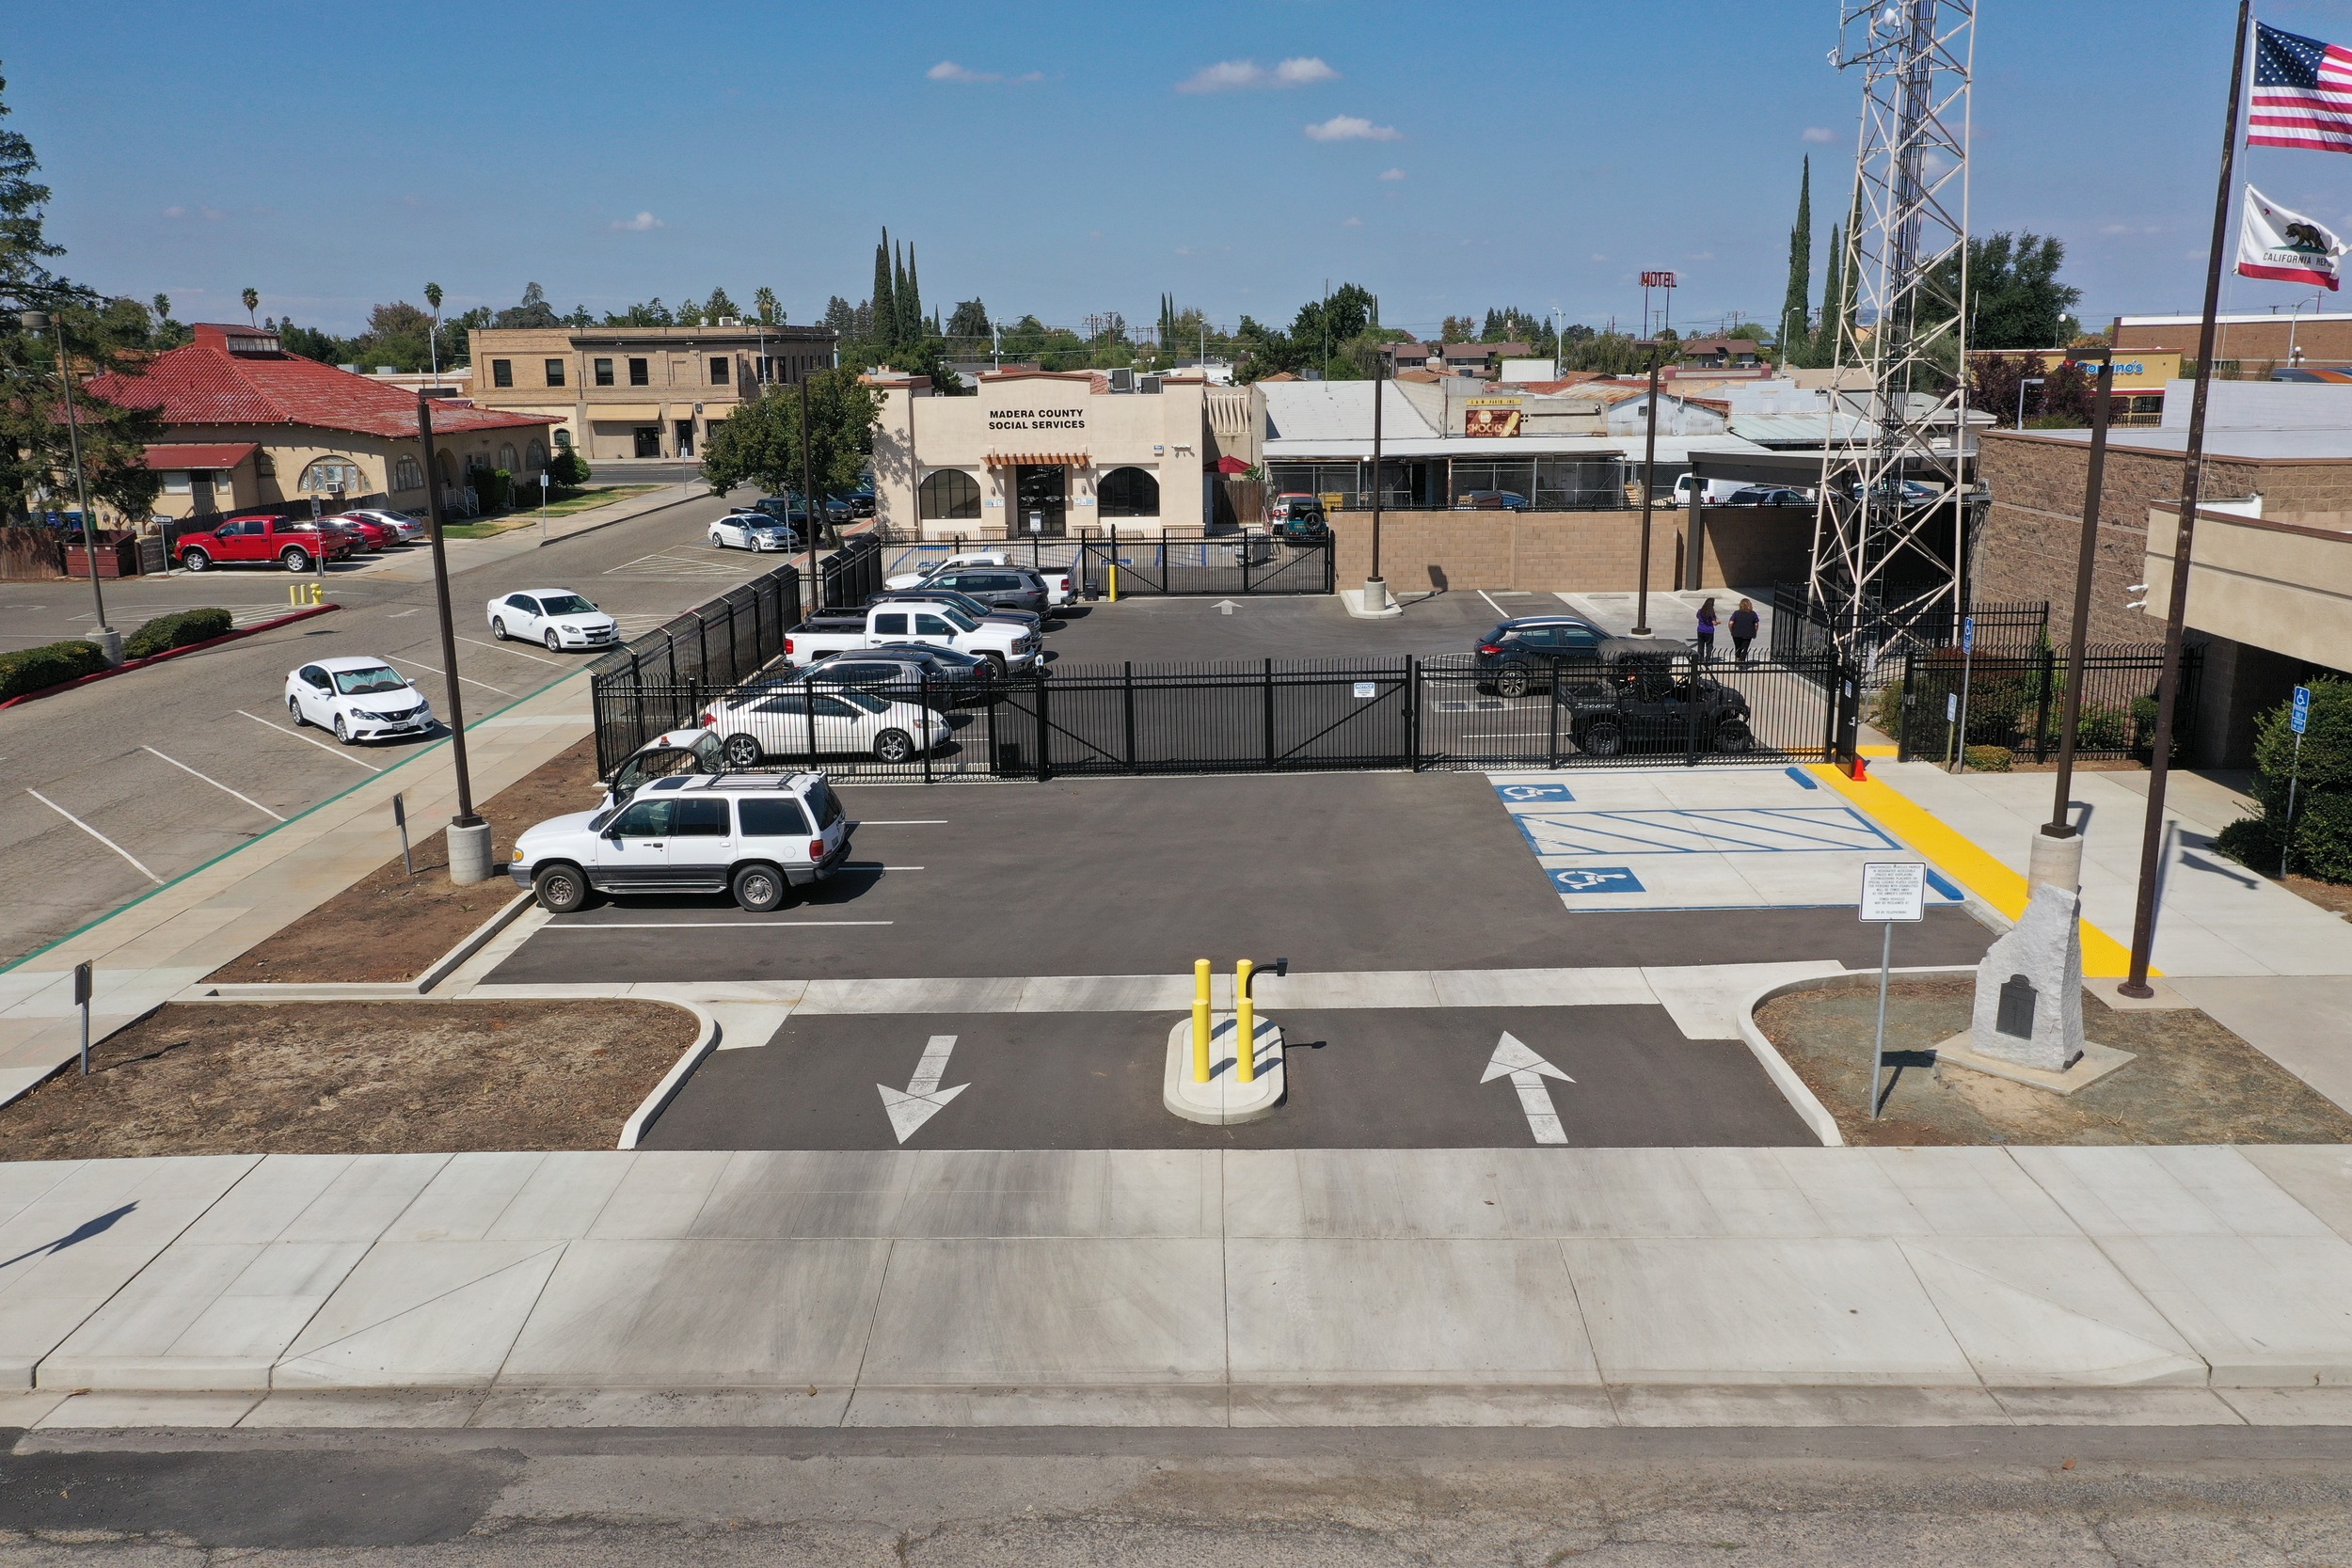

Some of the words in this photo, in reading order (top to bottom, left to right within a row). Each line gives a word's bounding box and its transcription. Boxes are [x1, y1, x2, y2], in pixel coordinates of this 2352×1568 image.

[2263, 252, 2312, 264] CALIFORNIA
[1641, 271, 1677, 287] MOTEL
[2075, 361, 2143, 373] ono's
[990, 410, 1035, 419] MADERA
[1039, 409, 1084, 418] COUNTY
[989, 421, 1028, 430] SOCIAL
[1032, 420, 1086, 429] SERVICES
